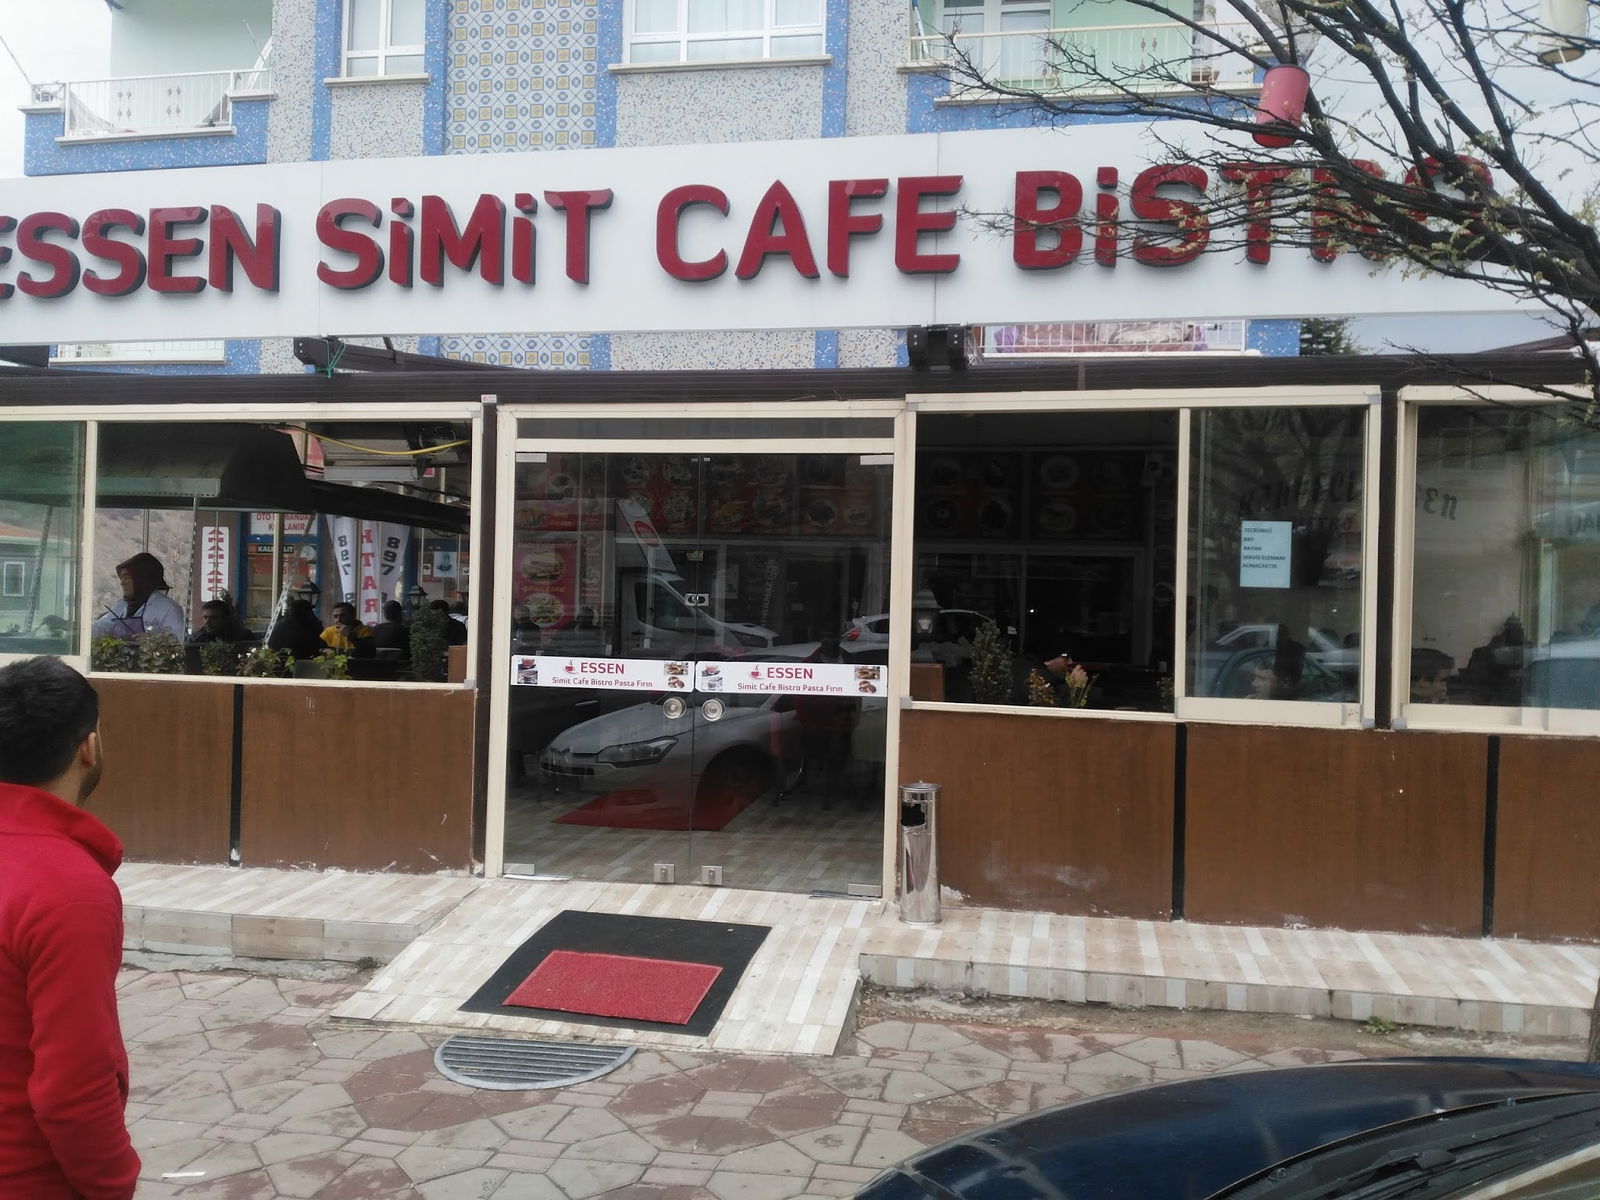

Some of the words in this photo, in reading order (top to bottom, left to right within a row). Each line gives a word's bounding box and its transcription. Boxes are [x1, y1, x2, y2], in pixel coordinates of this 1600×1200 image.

[656, 180, 964, 282] CAFE
[580, 661, 625, 675] ESSEN
[767, 667, 813, 680] ESSEN
[552, 676, 571, 685] Simit
[573, 677, 590, 686] Cafe
[590, 678, 613, 687] Bistro
[614, 679, 635, 688] Pasta
[737, 682, 757, 691] Simit
[759, 683, 776, 691] Cafe
[778, 683, 801, 692] Bistro
[802, 684, 825, 693] Pasta
